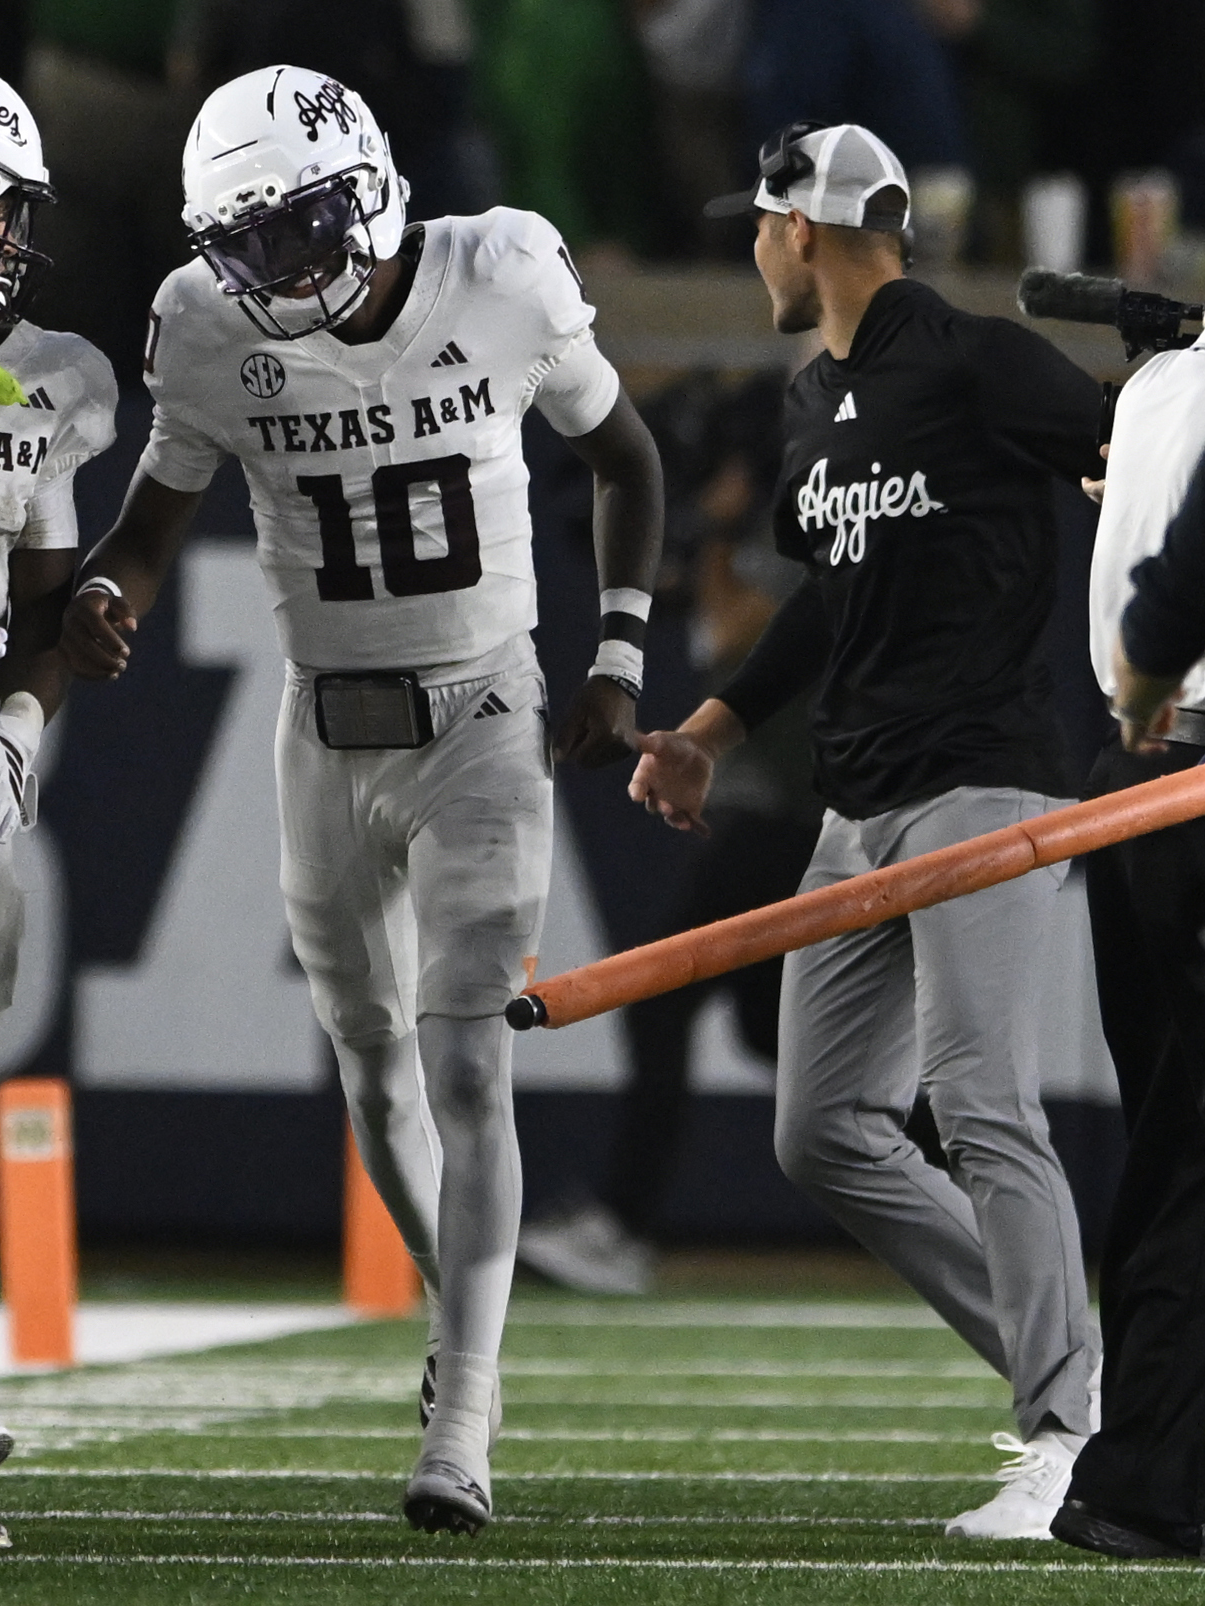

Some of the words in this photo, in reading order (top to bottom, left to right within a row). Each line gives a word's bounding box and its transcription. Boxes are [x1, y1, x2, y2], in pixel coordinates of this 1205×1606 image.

[241, 355, 286, 397] SEC
[247, 404, 396, 452] TEXAS
[410, 377, 496, 439] A&M
[296, 452, 483, 602] 10
[797, 457, 945, 567] Aggies
